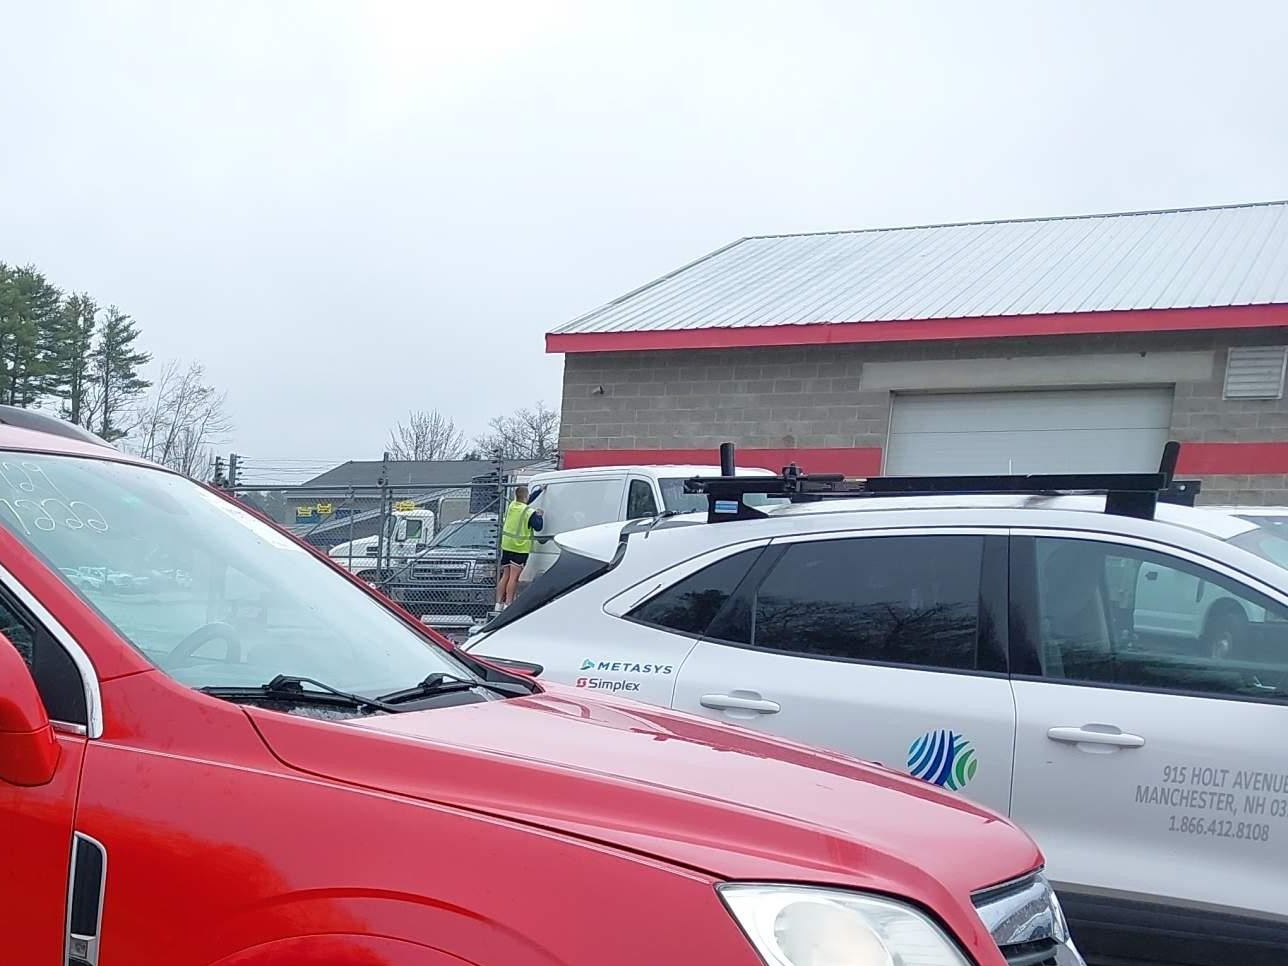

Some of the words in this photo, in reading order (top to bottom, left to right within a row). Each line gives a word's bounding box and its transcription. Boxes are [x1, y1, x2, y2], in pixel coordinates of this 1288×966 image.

[597, 661, 673, 674] METASYS
[588, 678, 641, 692] Simplex
[1162, 765, 1187, 784] 915
[1190, 767, 1230, 788] HOLT
[1135, 785, 1238, 816] MANCHESTER,
[1243, 796, 1266, 815] NH
[1168, 815, 1270, 842] 1.866.412.8108
